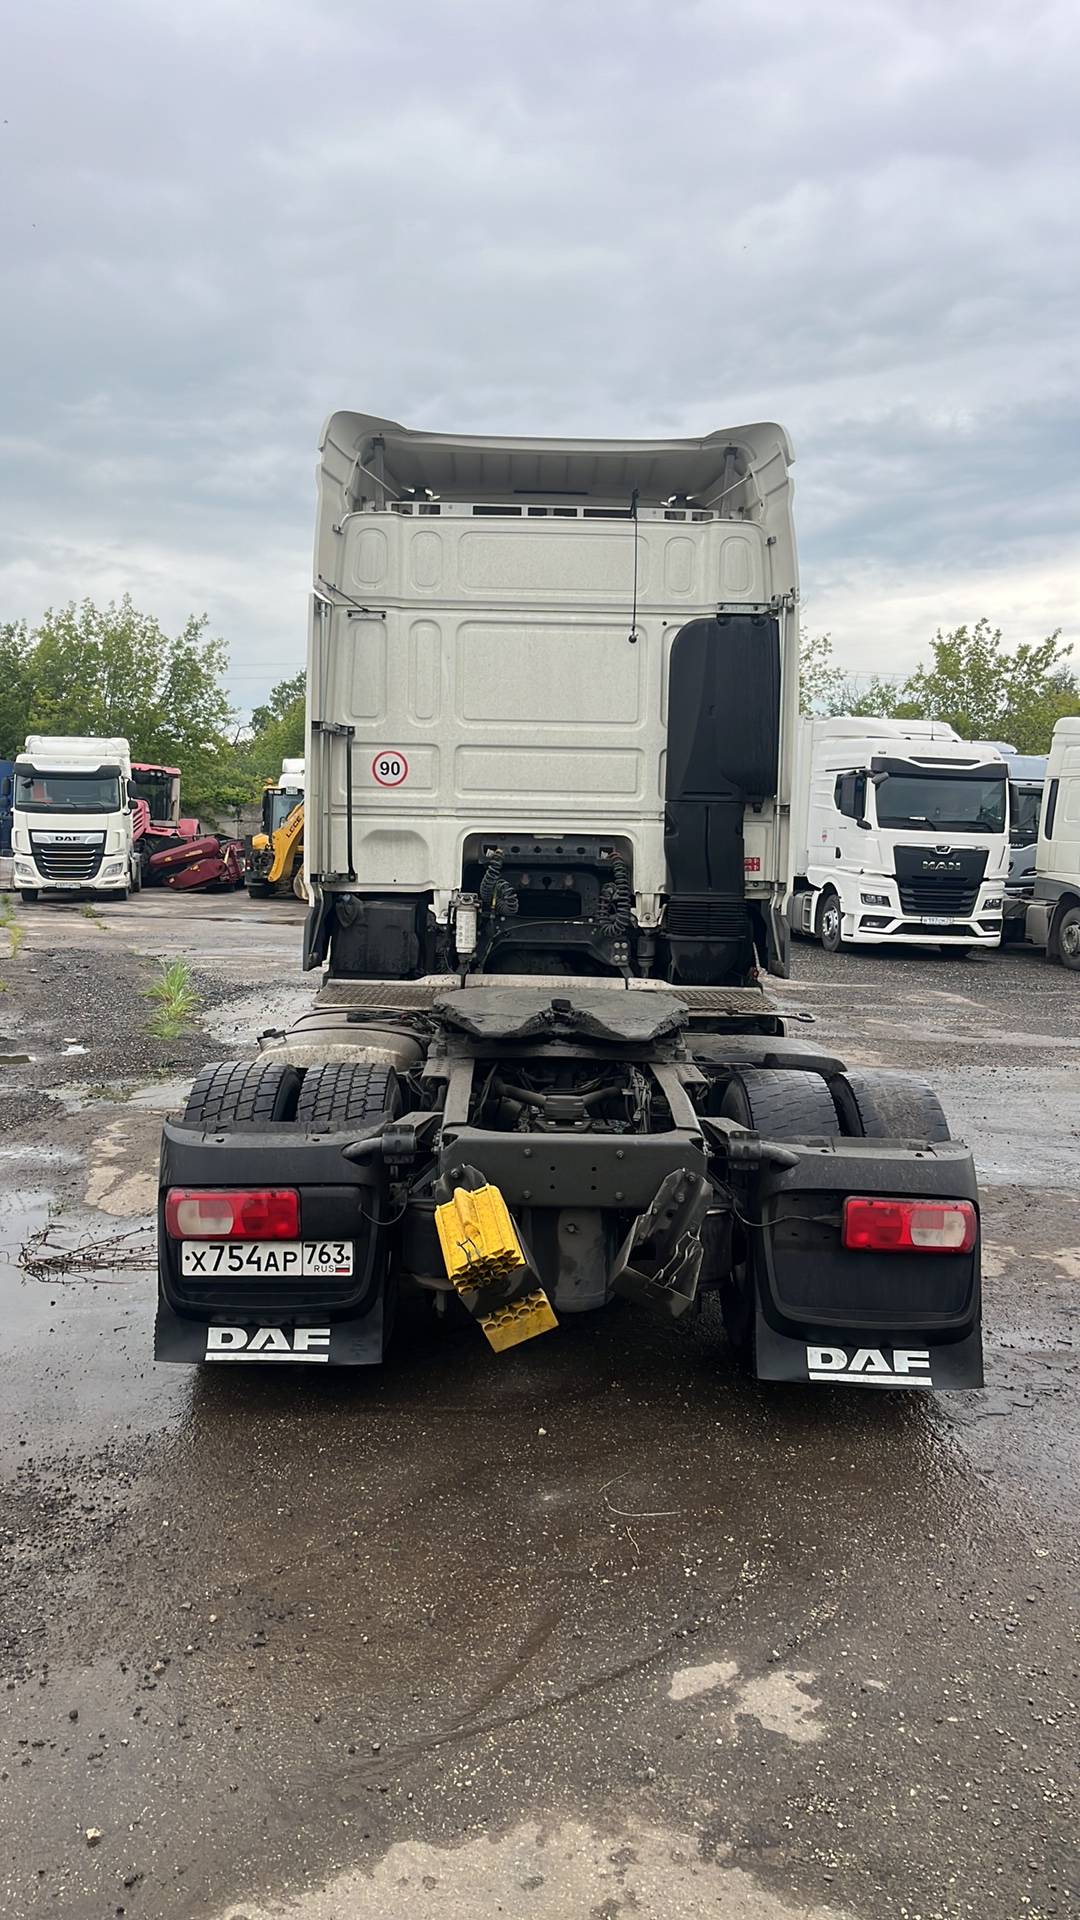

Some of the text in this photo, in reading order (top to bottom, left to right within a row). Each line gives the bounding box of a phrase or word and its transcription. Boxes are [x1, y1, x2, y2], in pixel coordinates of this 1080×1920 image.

[380, 761, 400, 776] 90
[922, 861, 960, 870] MAN
[304, 1244, 345, 1265] 763
[313, 1264, 335, 1273] RUS
[206, 1327, 331, 1351] DAF
[806, 1346, 931, 1373] DAF
